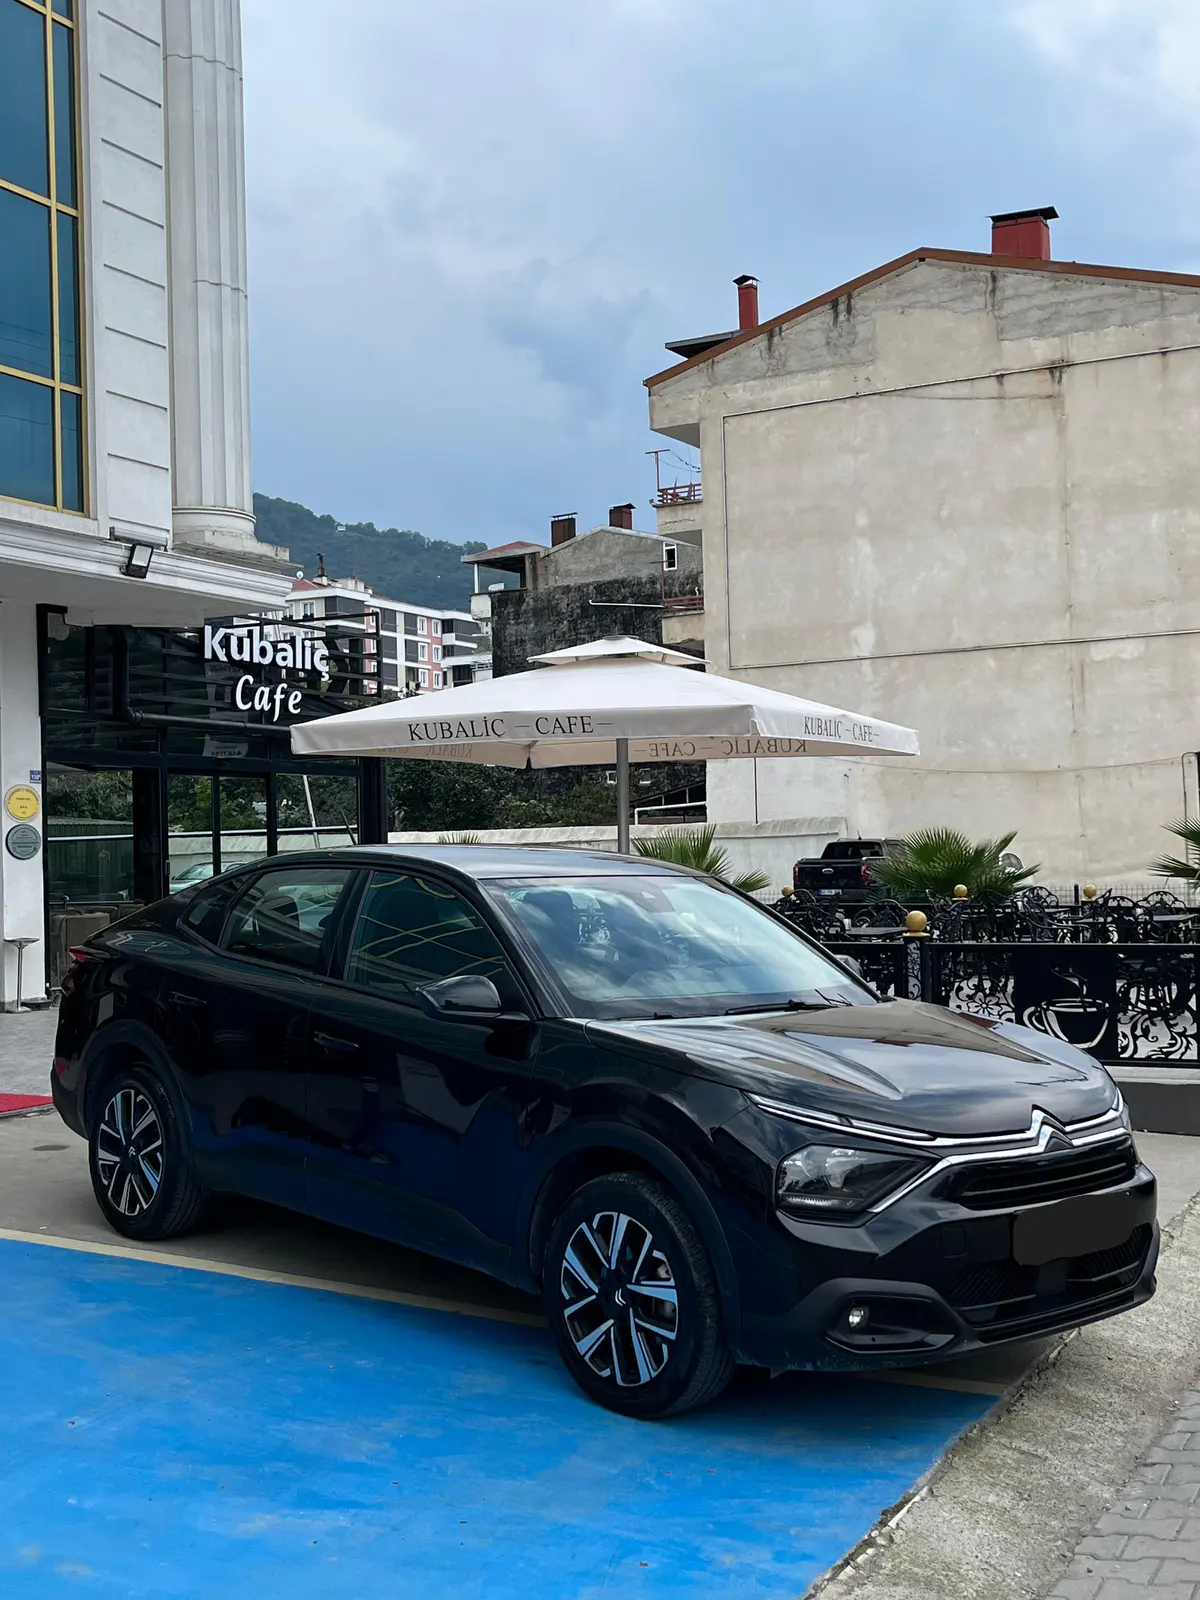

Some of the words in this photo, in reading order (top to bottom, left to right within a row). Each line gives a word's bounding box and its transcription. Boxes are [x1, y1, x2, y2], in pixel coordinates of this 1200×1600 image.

[204, 624, 329, 681] Kubaliç
[235, 674, 302, 722] Cafe
[408, 716, 506, 741] KUBALİÇ
[535, 715, 594, 734] CAFE
[804, 715, 843, 739] KUBALİÇ
[852, 723, 872, 742] CAFE
